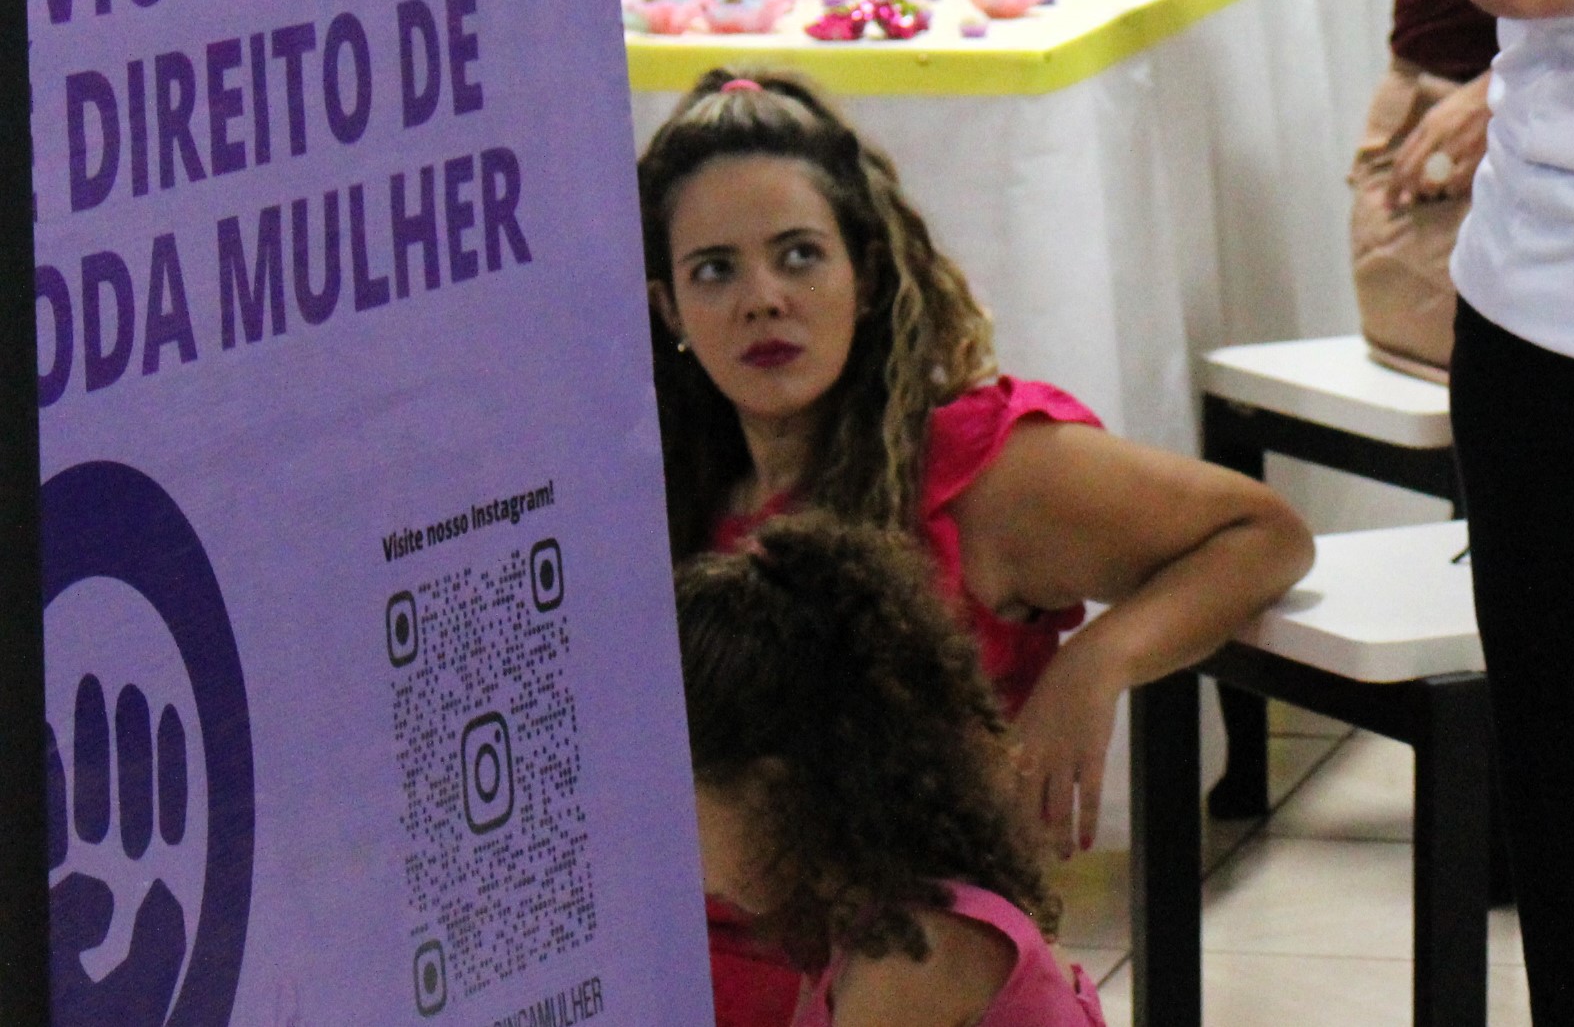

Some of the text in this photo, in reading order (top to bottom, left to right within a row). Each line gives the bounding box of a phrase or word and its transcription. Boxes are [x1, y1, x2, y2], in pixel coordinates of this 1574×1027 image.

[65, 11, 373, 213] DIREITO
[35, 145, 533, 409] ODA MULHER
[382, 478, 555, 562] Visite nosso Instagram!
